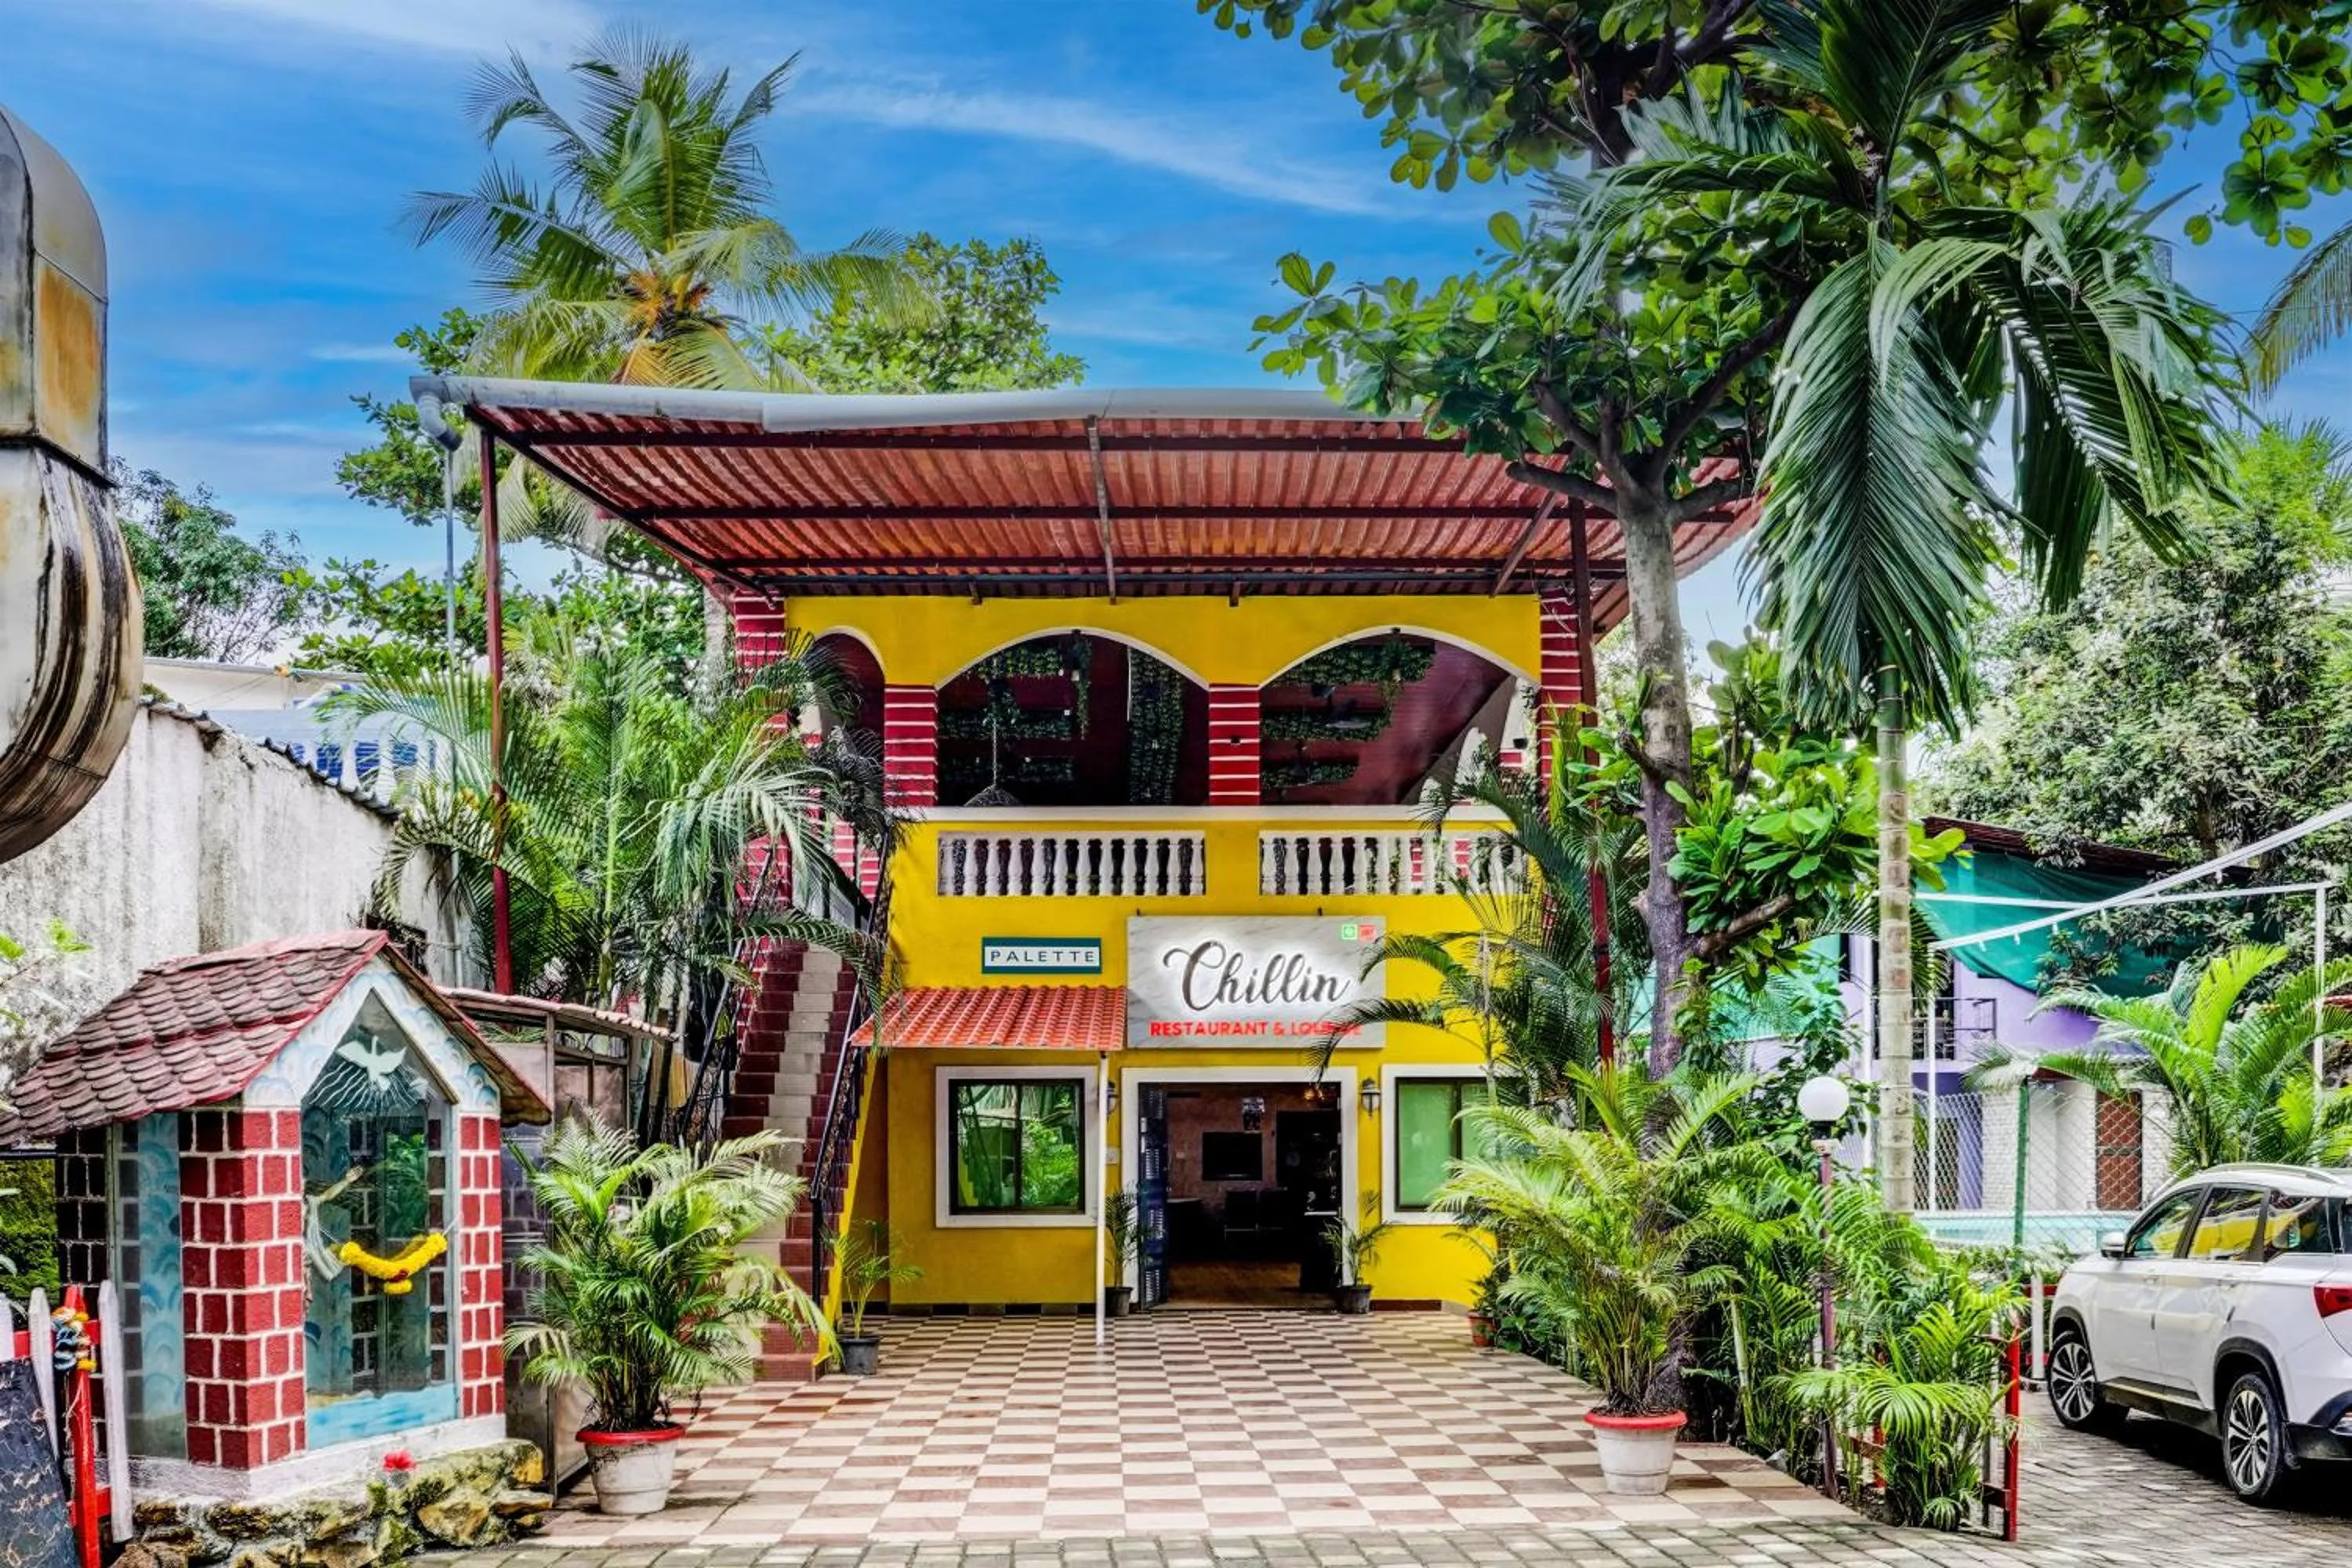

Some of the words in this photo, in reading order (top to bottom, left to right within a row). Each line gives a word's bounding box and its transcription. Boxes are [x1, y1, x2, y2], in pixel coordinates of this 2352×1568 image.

[990, 950, 1095, 962] PALETTE
[1163, 940, 1351, 1011] Chillin
[1150, 1021, 1268, 1036] RESTAURANT
[1272, 1022, 1284, 1036] &
